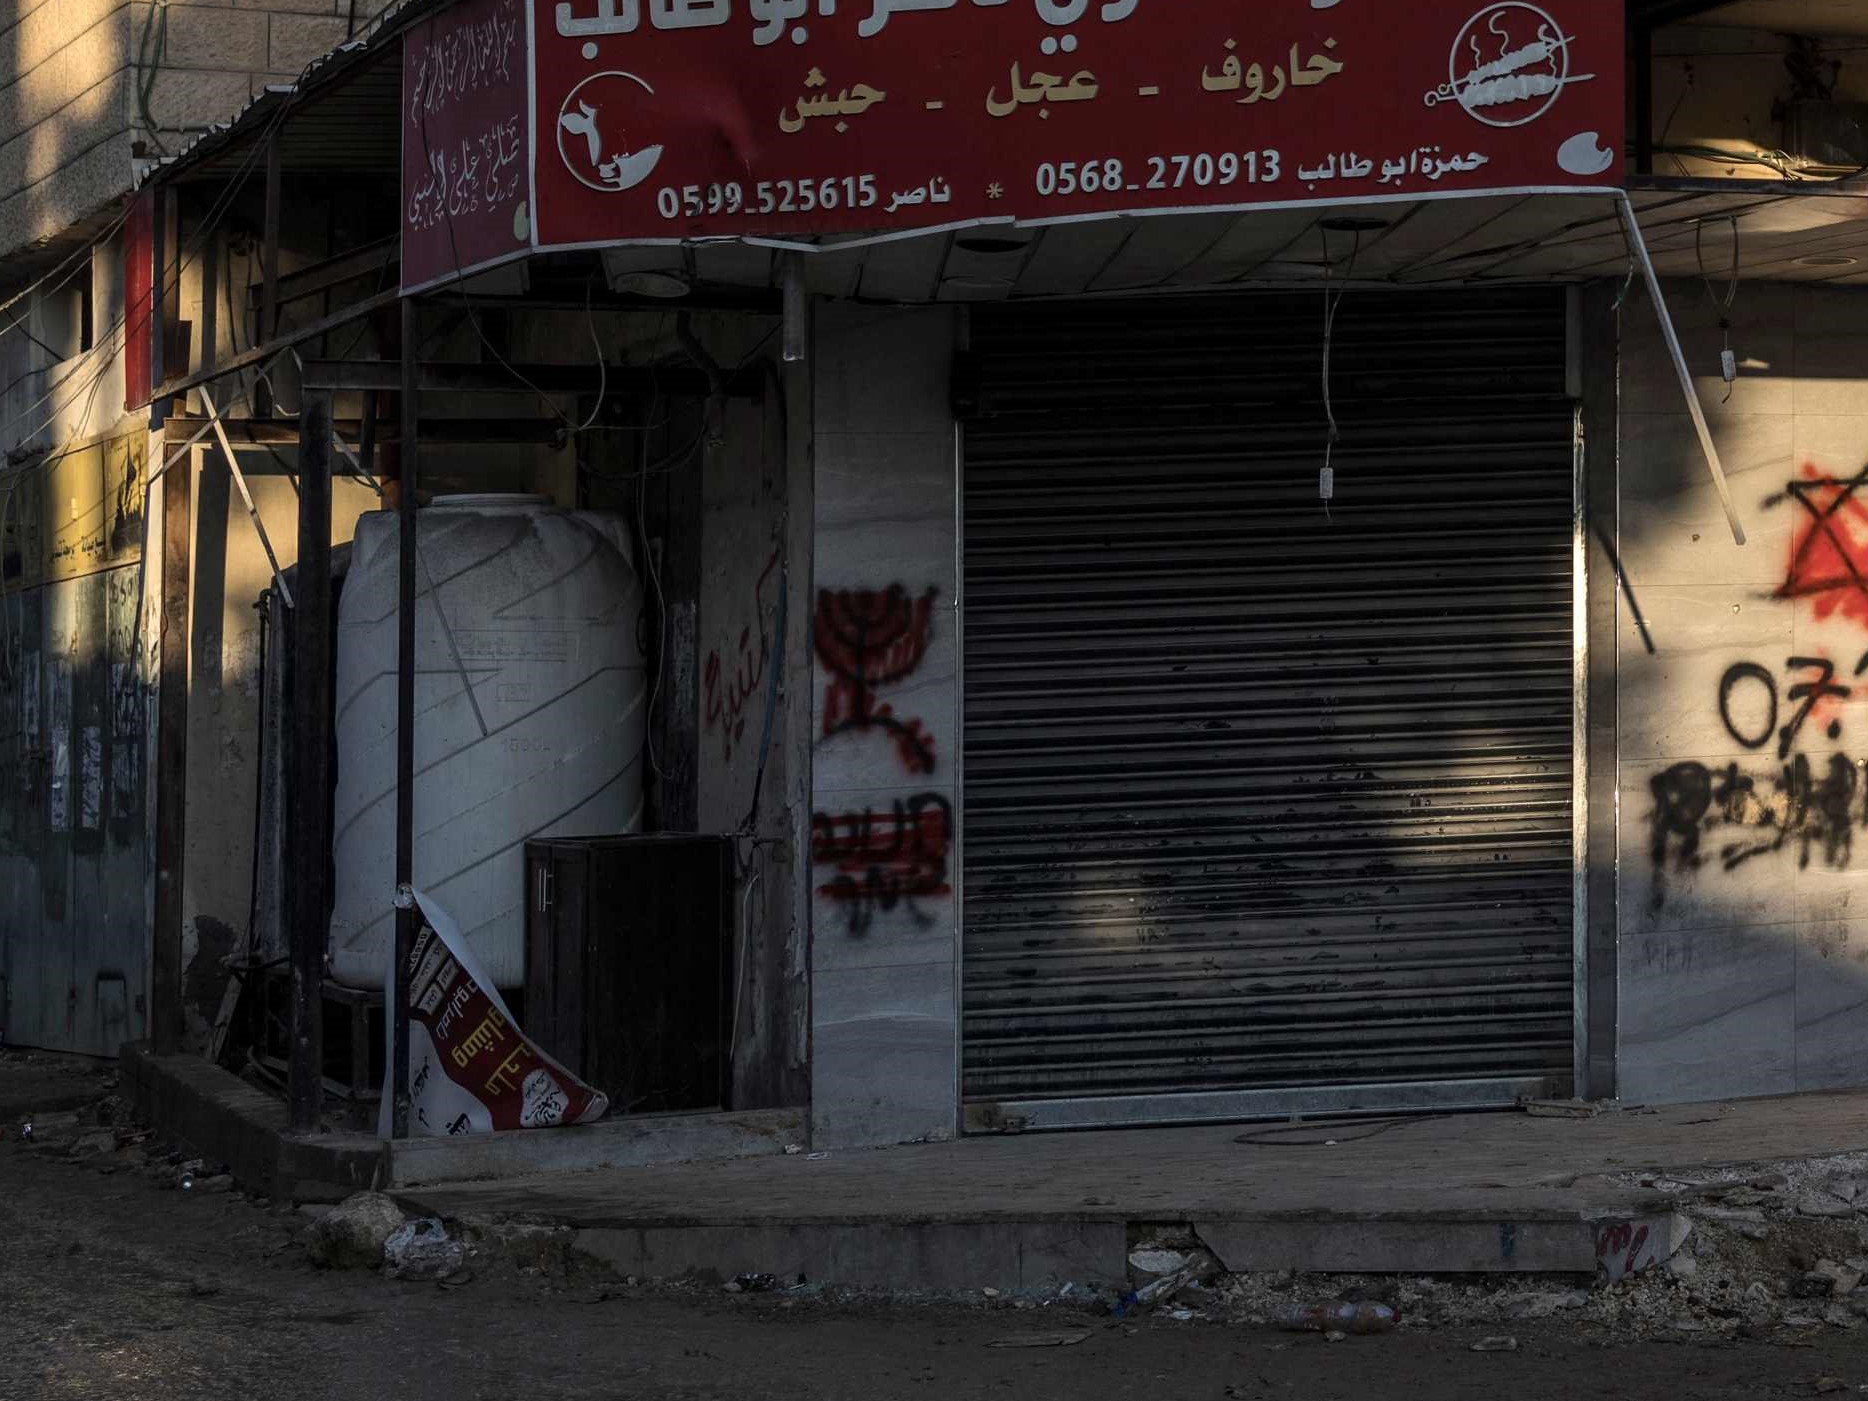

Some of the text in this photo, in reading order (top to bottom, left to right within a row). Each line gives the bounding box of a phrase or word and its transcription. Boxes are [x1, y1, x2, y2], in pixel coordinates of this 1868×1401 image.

[985, 59, 1099, 120] عجل
[1200, 37, 1344, 106] خاروف
[778, 66, 886, 134] حبش
[1297, 151, 1374, 193] طالب
[1419, 145, 1489, 181] حمزة
[883, 178, 951, 213] ناصر
